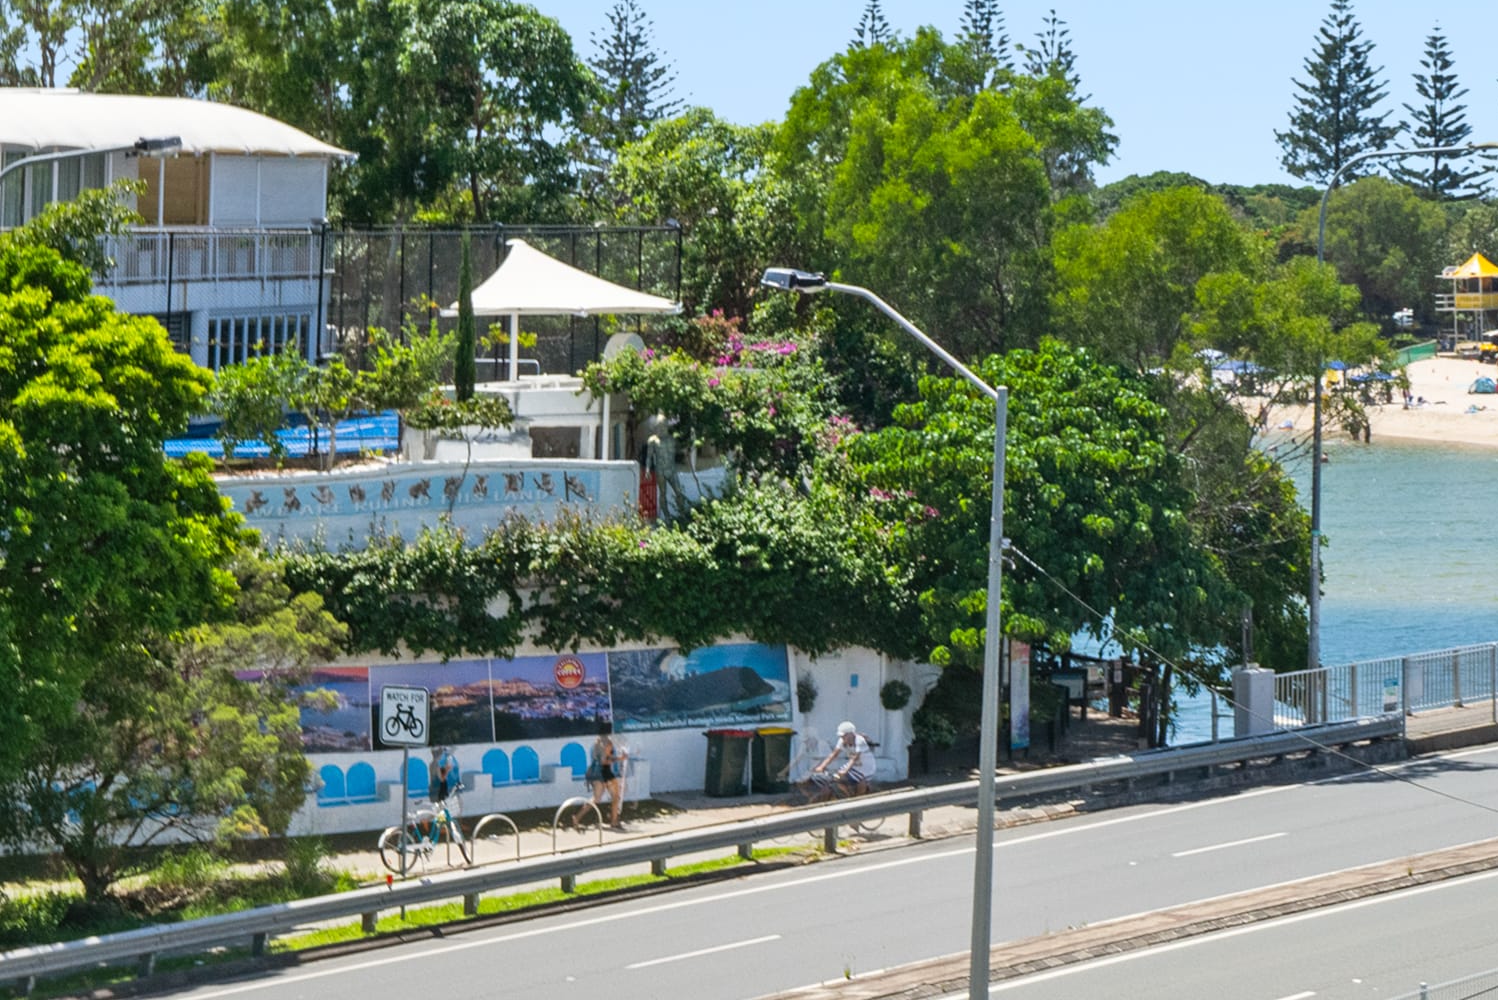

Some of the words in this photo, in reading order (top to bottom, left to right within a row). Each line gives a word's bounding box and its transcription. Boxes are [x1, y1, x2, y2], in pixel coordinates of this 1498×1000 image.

[299, 503, 338, 516] ARE
[495, 488, 549, 501] LAND
[386, 692, 408, 701] WATCH
[411, 693, 424, 702] FOR
